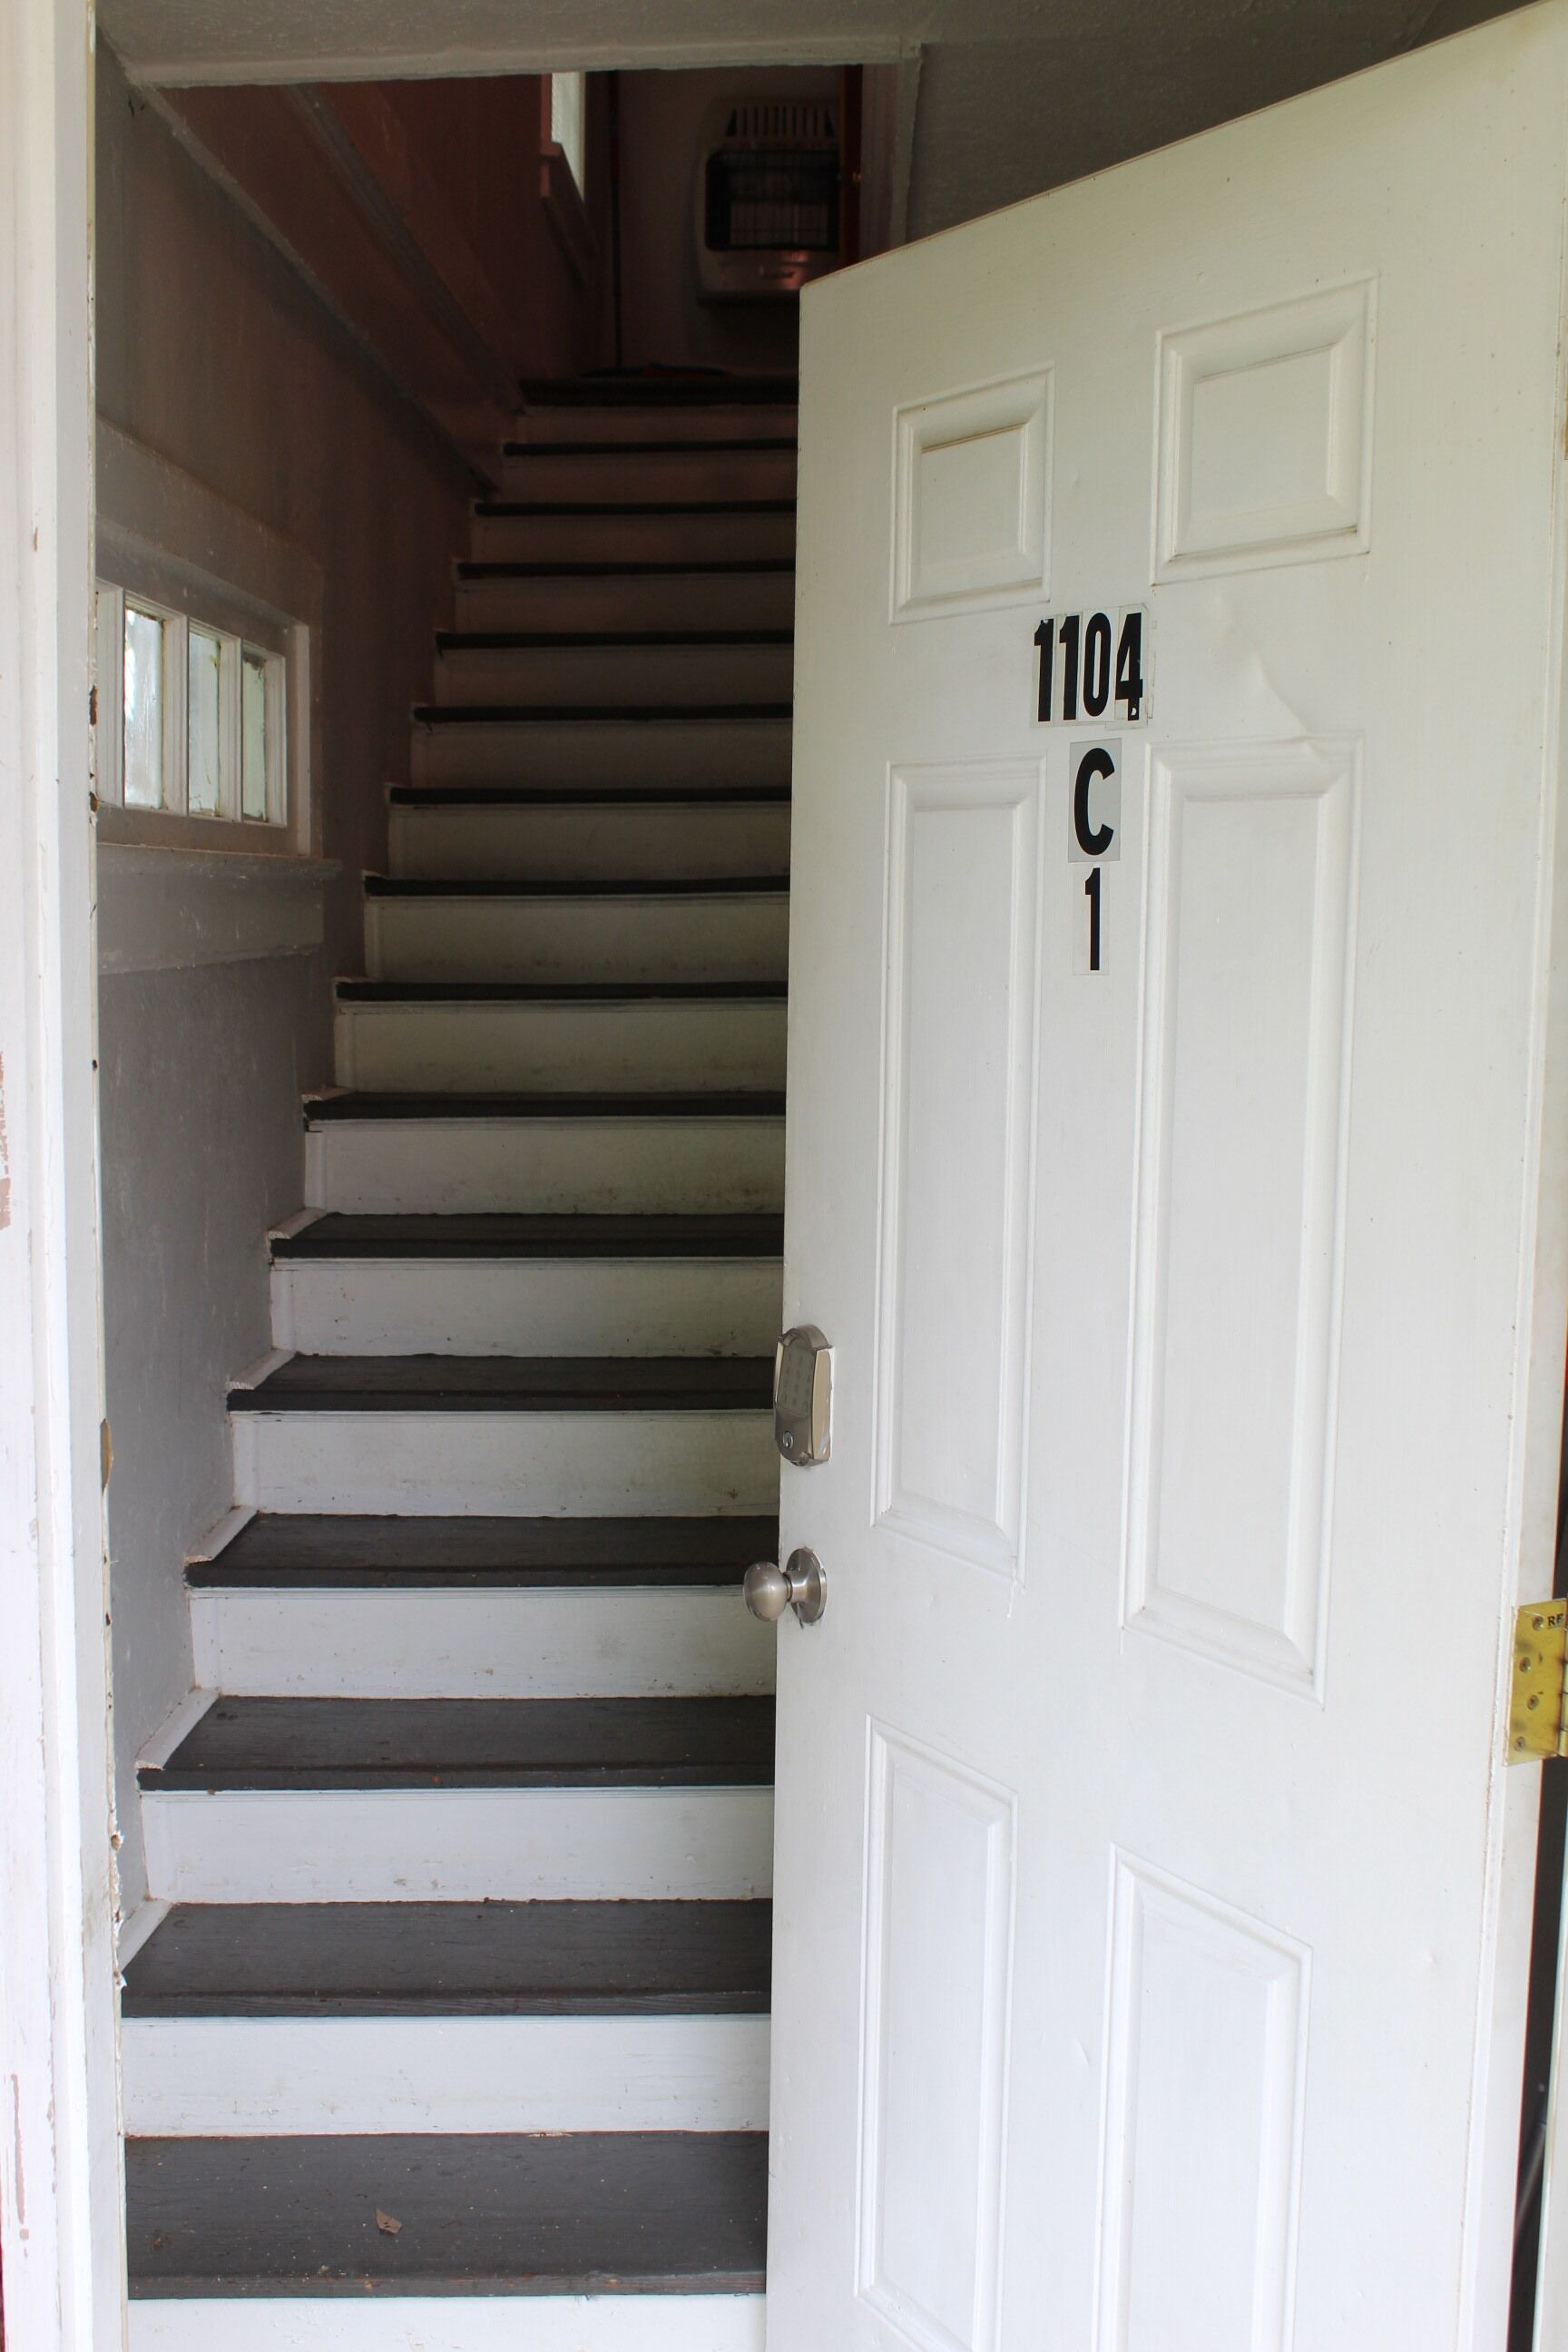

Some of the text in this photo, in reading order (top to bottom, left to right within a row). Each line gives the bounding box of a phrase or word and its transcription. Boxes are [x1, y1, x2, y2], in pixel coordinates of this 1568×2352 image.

[1034, 612, 1143, 722] 1104
[1073, 747, 1115, 856] C
[1084, 867, 1101, 971] 1
